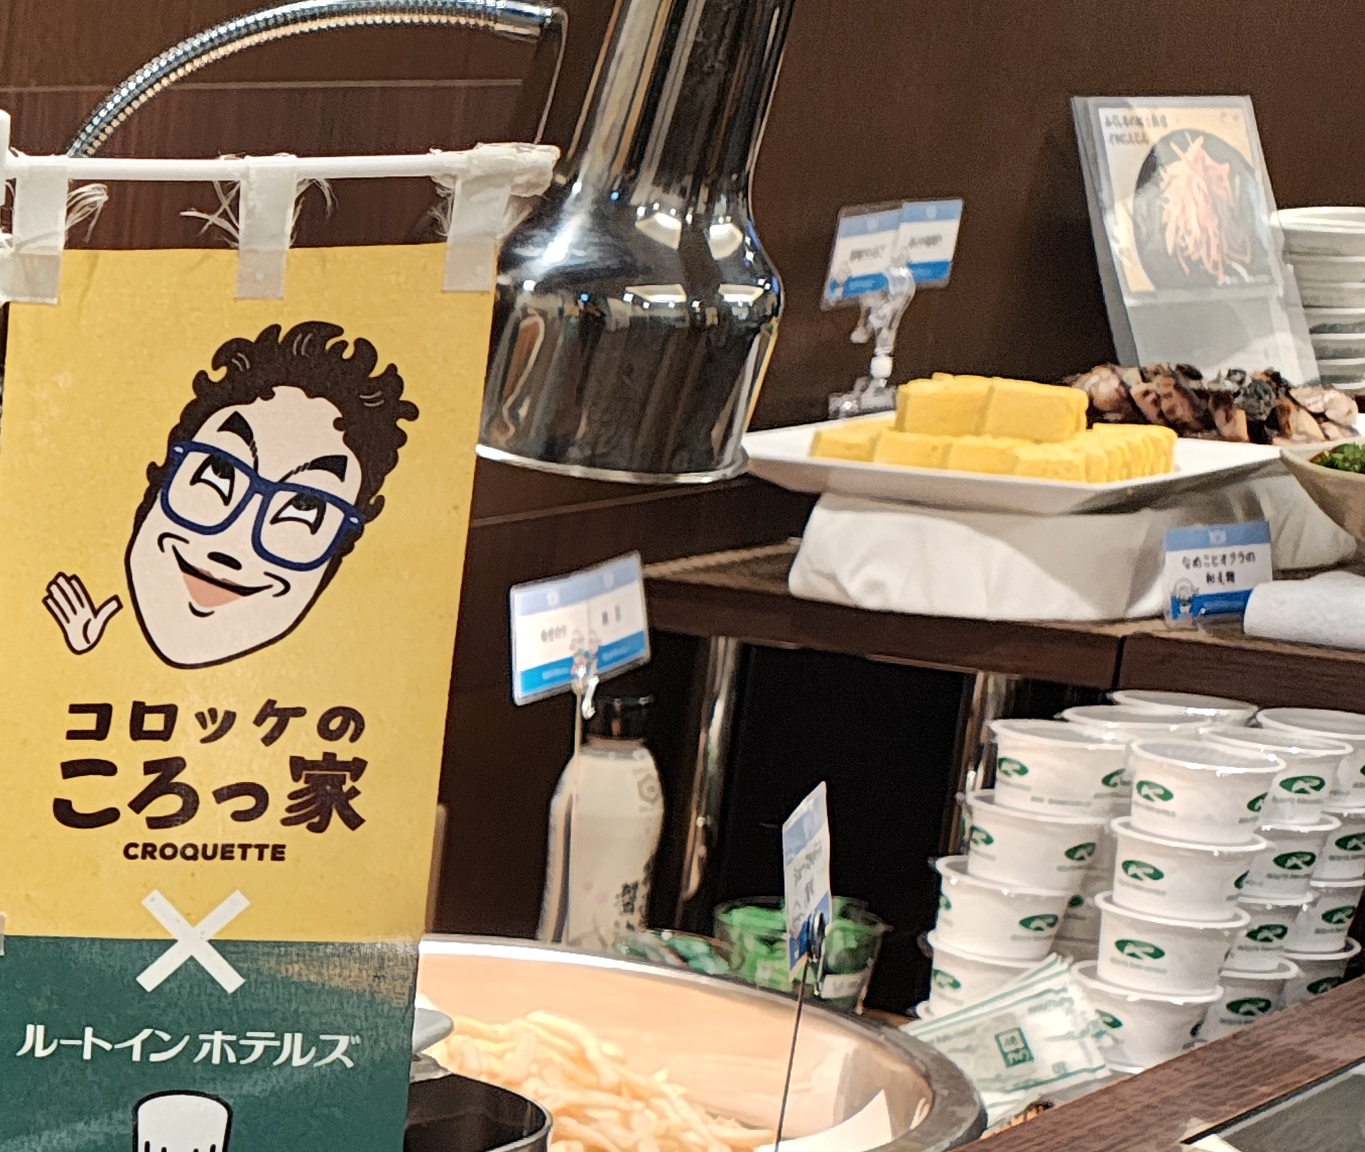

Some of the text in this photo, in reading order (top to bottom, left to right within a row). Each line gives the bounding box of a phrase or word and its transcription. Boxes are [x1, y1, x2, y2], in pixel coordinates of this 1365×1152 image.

[65, 699, 365, 748] コロッケの
[52, 752, 369, 833] ころっ家
[123, 842, 287, 862] CROQUETTE
